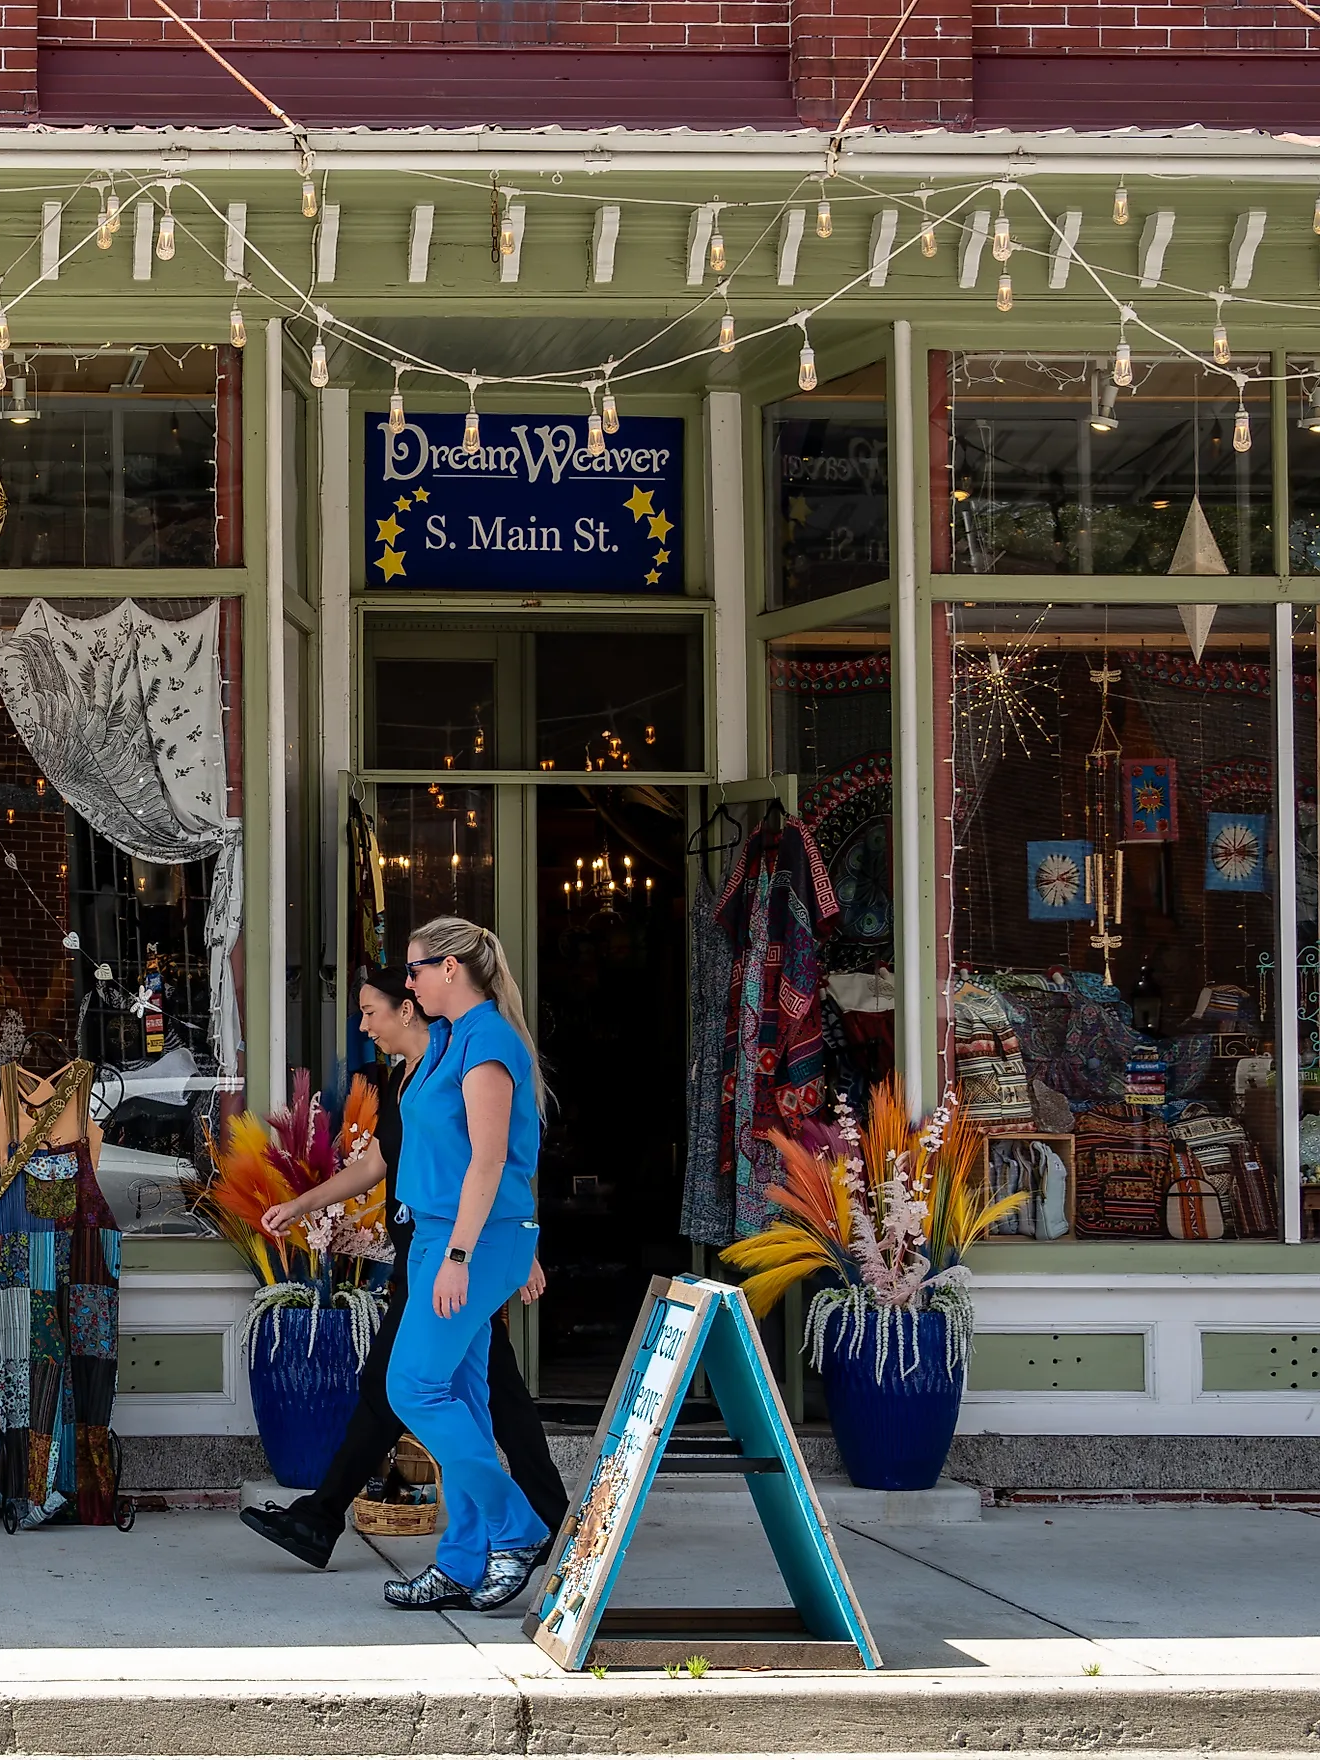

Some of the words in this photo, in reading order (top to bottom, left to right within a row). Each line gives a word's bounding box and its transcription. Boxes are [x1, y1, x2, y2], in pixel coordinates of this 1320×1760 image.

[377, 422, 520, 482] Dream
[510, 424, 671, 484] Weaver
[425, 514, 456, 550] S.
[467, 515, 563, 551] Main
[573, 517, 619, 553] St.
